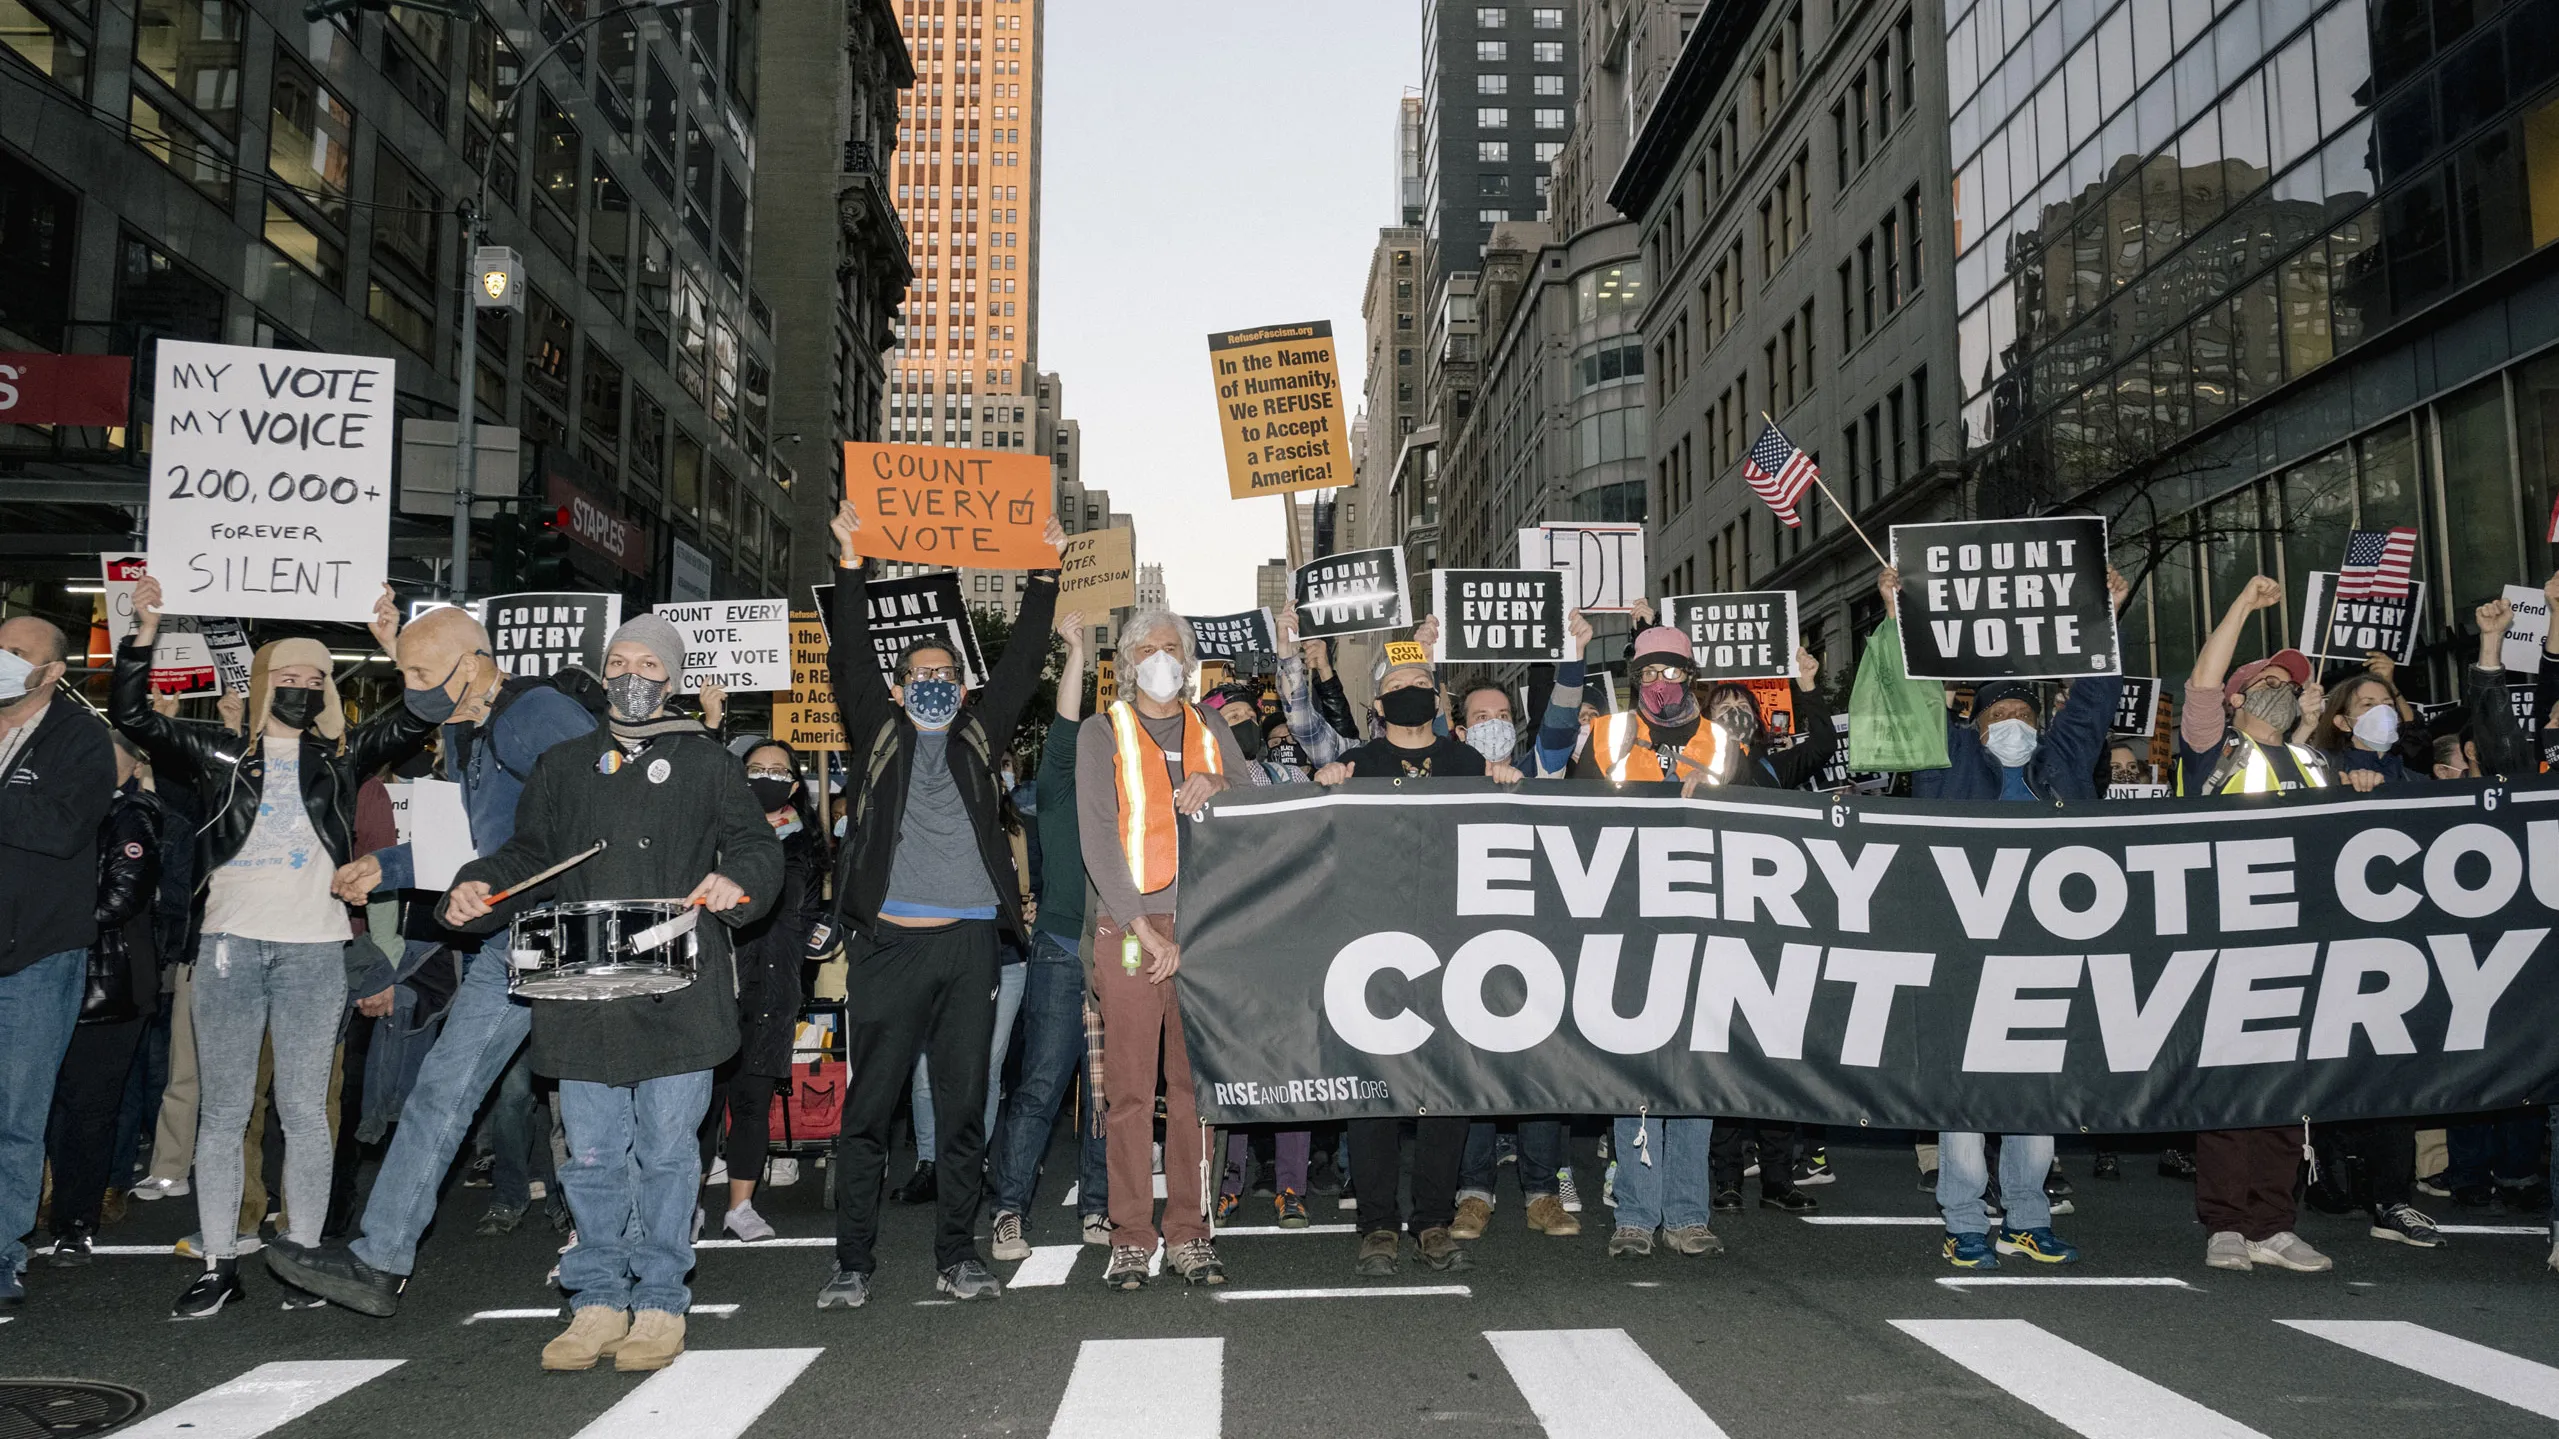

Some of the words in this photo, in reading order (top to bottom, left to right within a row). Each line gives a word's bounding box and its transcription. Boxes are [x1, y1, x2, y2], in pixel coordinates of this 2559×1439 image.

[1227, 325, 1314, 345] RefuseFascism.org
[1219, 358, 1237, 376] In
[1243, 354, 1273, 371] the
[1278, 349, 1330, 368] Name
[172, 363, 233, 392] MY
[258, 363, 380, 403] VOTE
[1221, 380, 1239, 399] of
[1245, 370, 1337, 396] Humanity,
[1229, 403, 1258, 421] We
[1264, 392, 1334, 416] REFUSE
[170, 408, 233, 436] MY
[240, 408, 373, 450] VOICE
[1242, 426, 1261, 442] to
[1266, 416, 1330, 440] Accept
[1248, 452, 1258, 465] a
[1264, 438, 1331, 461] Fascist
[872, 451, 993, 486] COUNT
[1250, 462, 1333, 489] America!
[168, 465, 381, 505] 200,000+
[877, 486, 1000, 521] EVERY
[210, 523, 324, 543] FOREVER
[573, 497, 625, 557] STAPLES
[881, 525, 1000, 552] VOTE
[1068, 539, 1095, 551] TOP
[1926, 539, 2078, 574] COUNT
[188, 552, 352, 599] SILENT
[1062, 569, 1130, 592] UPPRESSION
[1307, 560, 1379, 584] COUNT
[1307, 576, 1382, 599] EVERY
[1462, 582, 1546, 599] COUNT
[1926, 573, 2078, 612] EVERY
[497, 606, 587, 626] COUNT
[659, 607, 713, 623] COUNT
[726, 604, 784, 622] EVERY
[1310, 600, 1385, 627] VOTE
[1463, 600, 1544, 622] EVERY
[1690, 603, 1770, 622] COUNT
[2335, 602, 2406, 627] EVERY
[2511, 601, 2547, 616] efend
[693, 628, 742, 644] VOTE.
[1192, 617, 1252, 631] COUNT
[1196, 627, 1254, 643] EVERY
[1692, 620, 1770, 643] EVERY
[496, 627, 587, 650] EVERY
[798, 630, 822, 644] the
[1199, 641, 1260, 656] VOTE
[1463, 624, 1547, 650] VOTE
[1929, 615, 2081, 658] VOTE
[2333, 624, 2403, 652] VOTE
[731, 649, 779, 664] VOTE
[1391, 646, 1419, 655] OUT
[1391, 653, 1424, 663] NOW
[1697, 643, 1773, 669] VOTE
[495, 653, 584, 677] VOTE
[1103, 667, 1114, 679] In
[683, 672, 758, 690] COUNTS.
[1100, 684, 1113, 696] of
[790, 689, 803, 703] to
[791, 711, 799, 723] a
[1456, 823, 1900, 934] EVERY
[1929, 836, 2300, 940] VOTE
[1323, 928, 1936, 1068] COUNT
[1962, 927, 2552, 1073] EVERY
[1214, 1076, 1389, 1106] RISEANDRESIST.ORG
